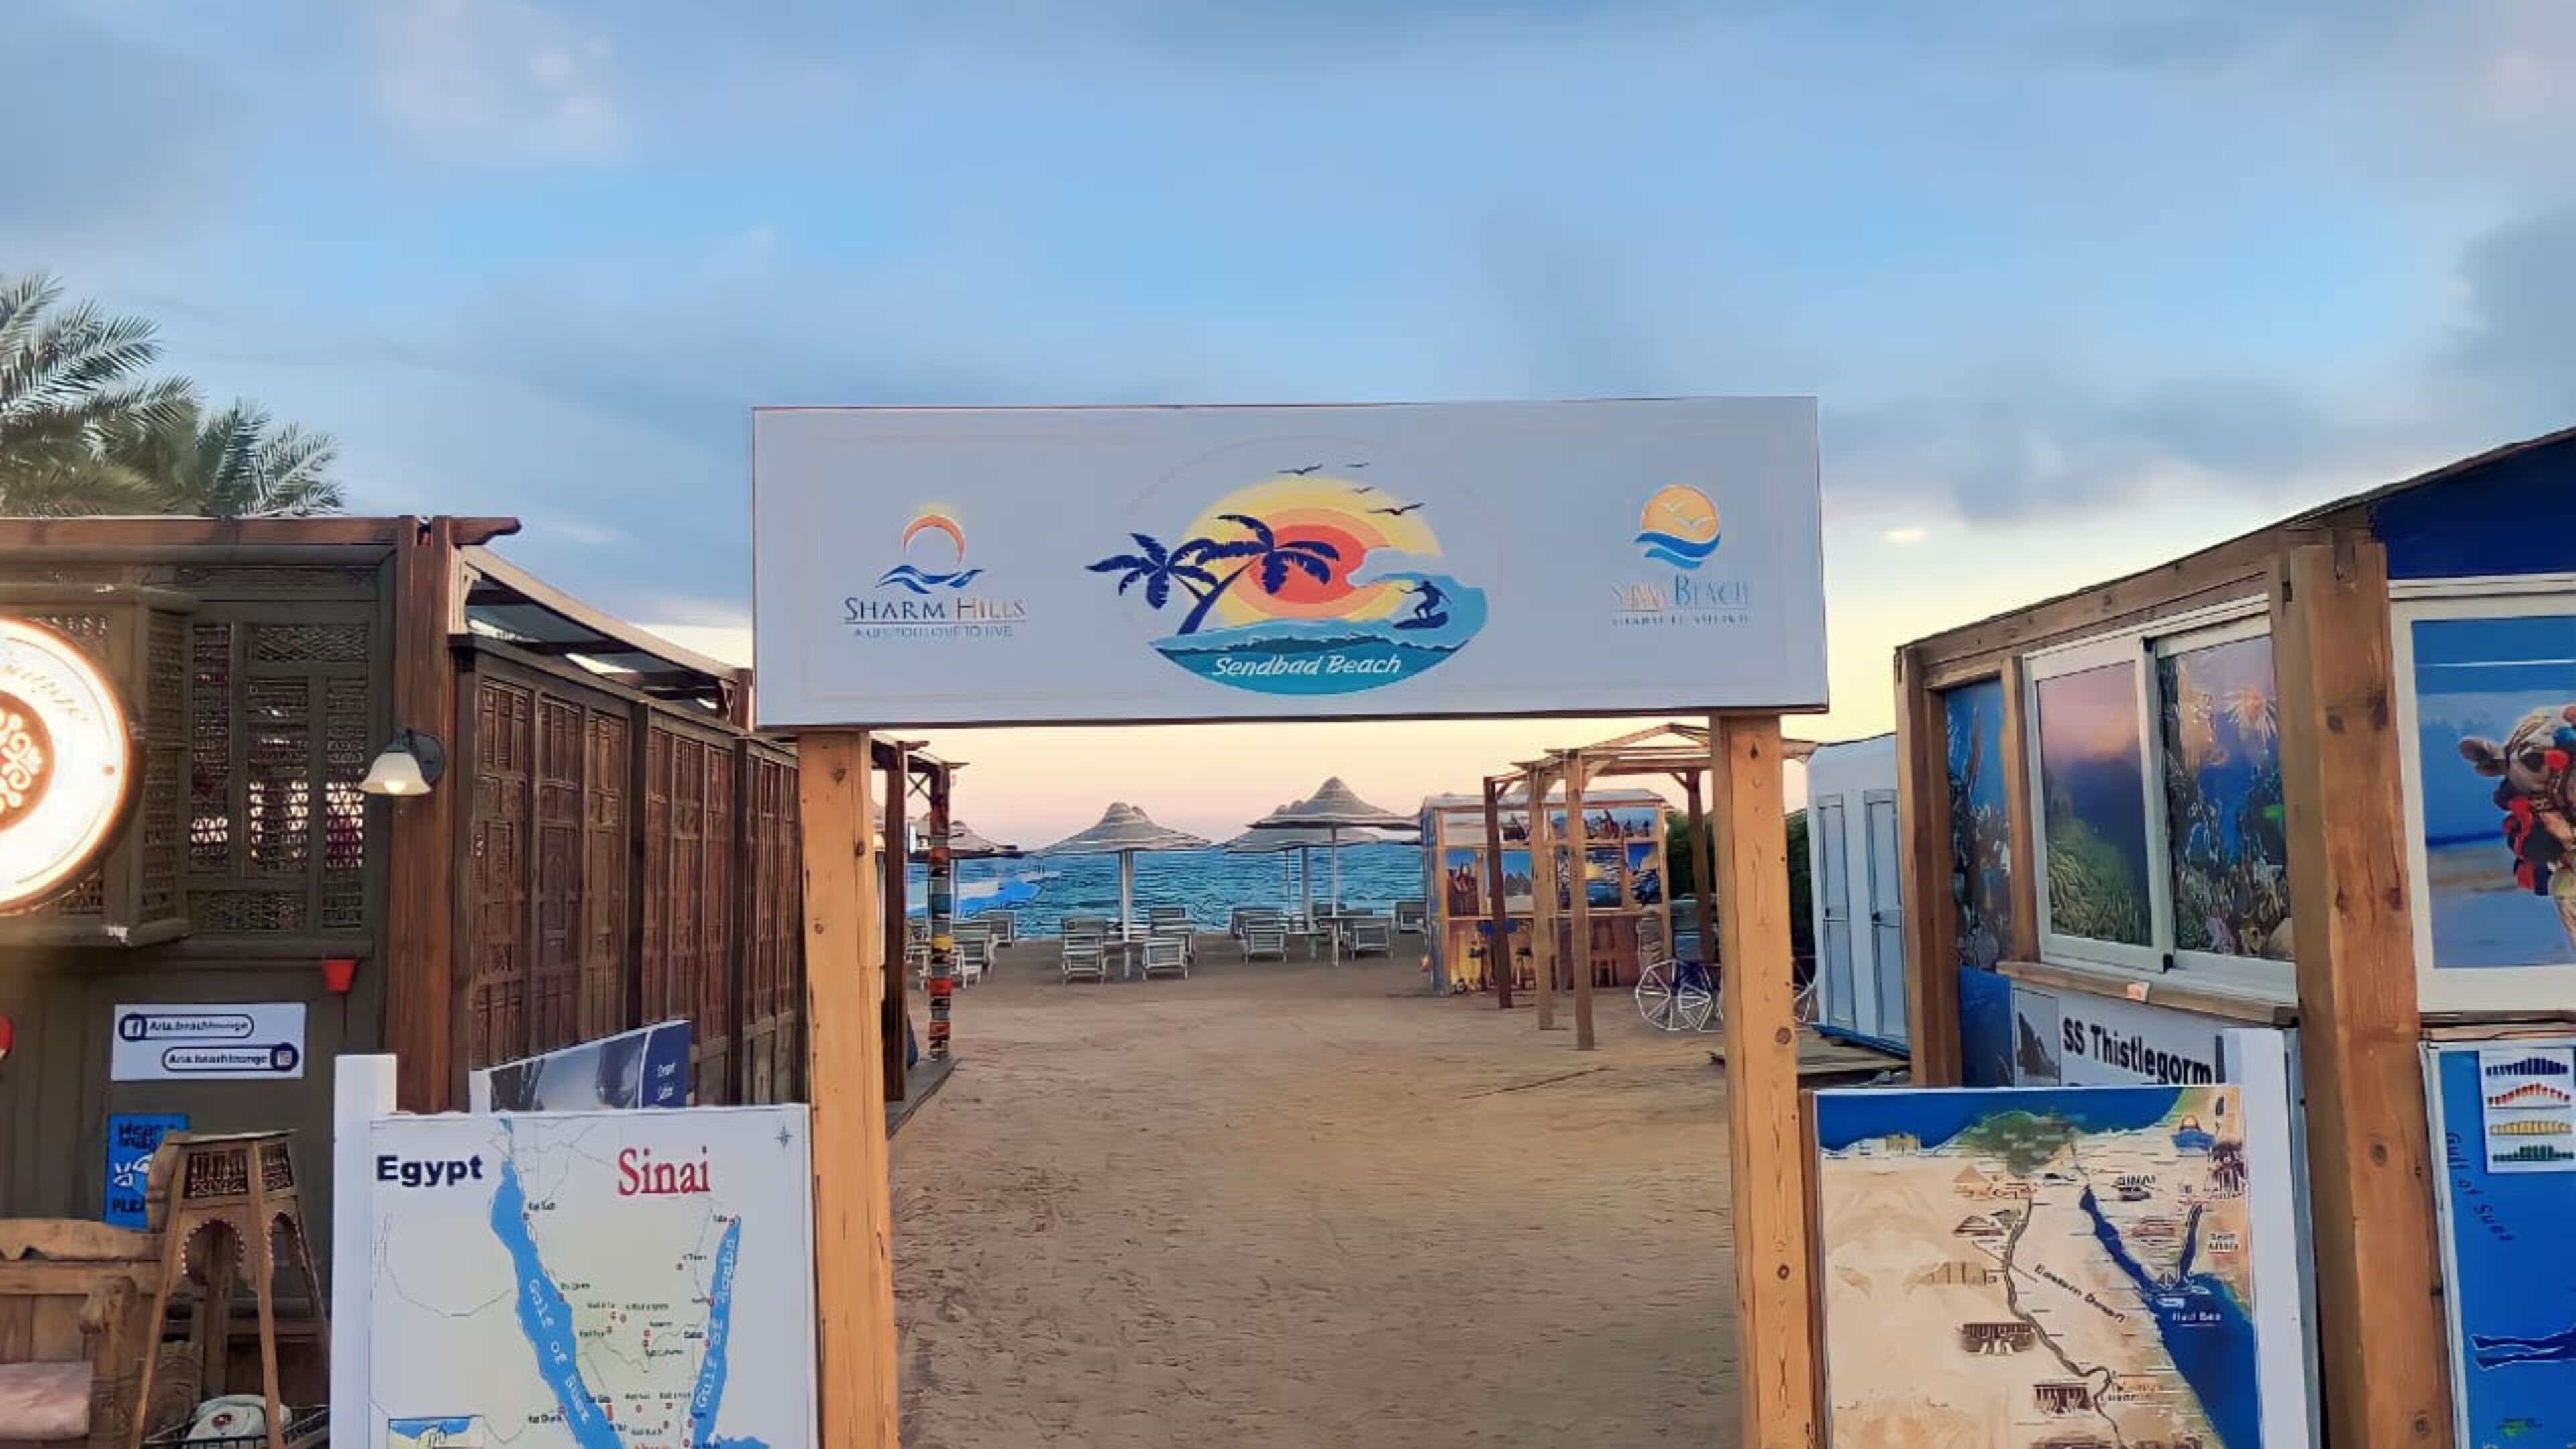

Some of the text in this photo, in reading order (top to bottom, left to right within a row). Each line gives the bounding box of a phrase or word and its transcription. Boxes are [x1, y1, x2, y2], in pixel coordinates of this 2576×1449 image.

[844, 596, 1026, 620] SHARM HILLS
[1212, 654, 1402, 676] Sendbad Beach
[2062, 1016, 2212, 1085] SS Thistlegorm
[376, 1153, 483, 1187] Egypt
[618, 1145, 711, 1195] Sinai
[529, 1279, 554, 1328] Gulf
[551, 1341, 568, 1366] of
